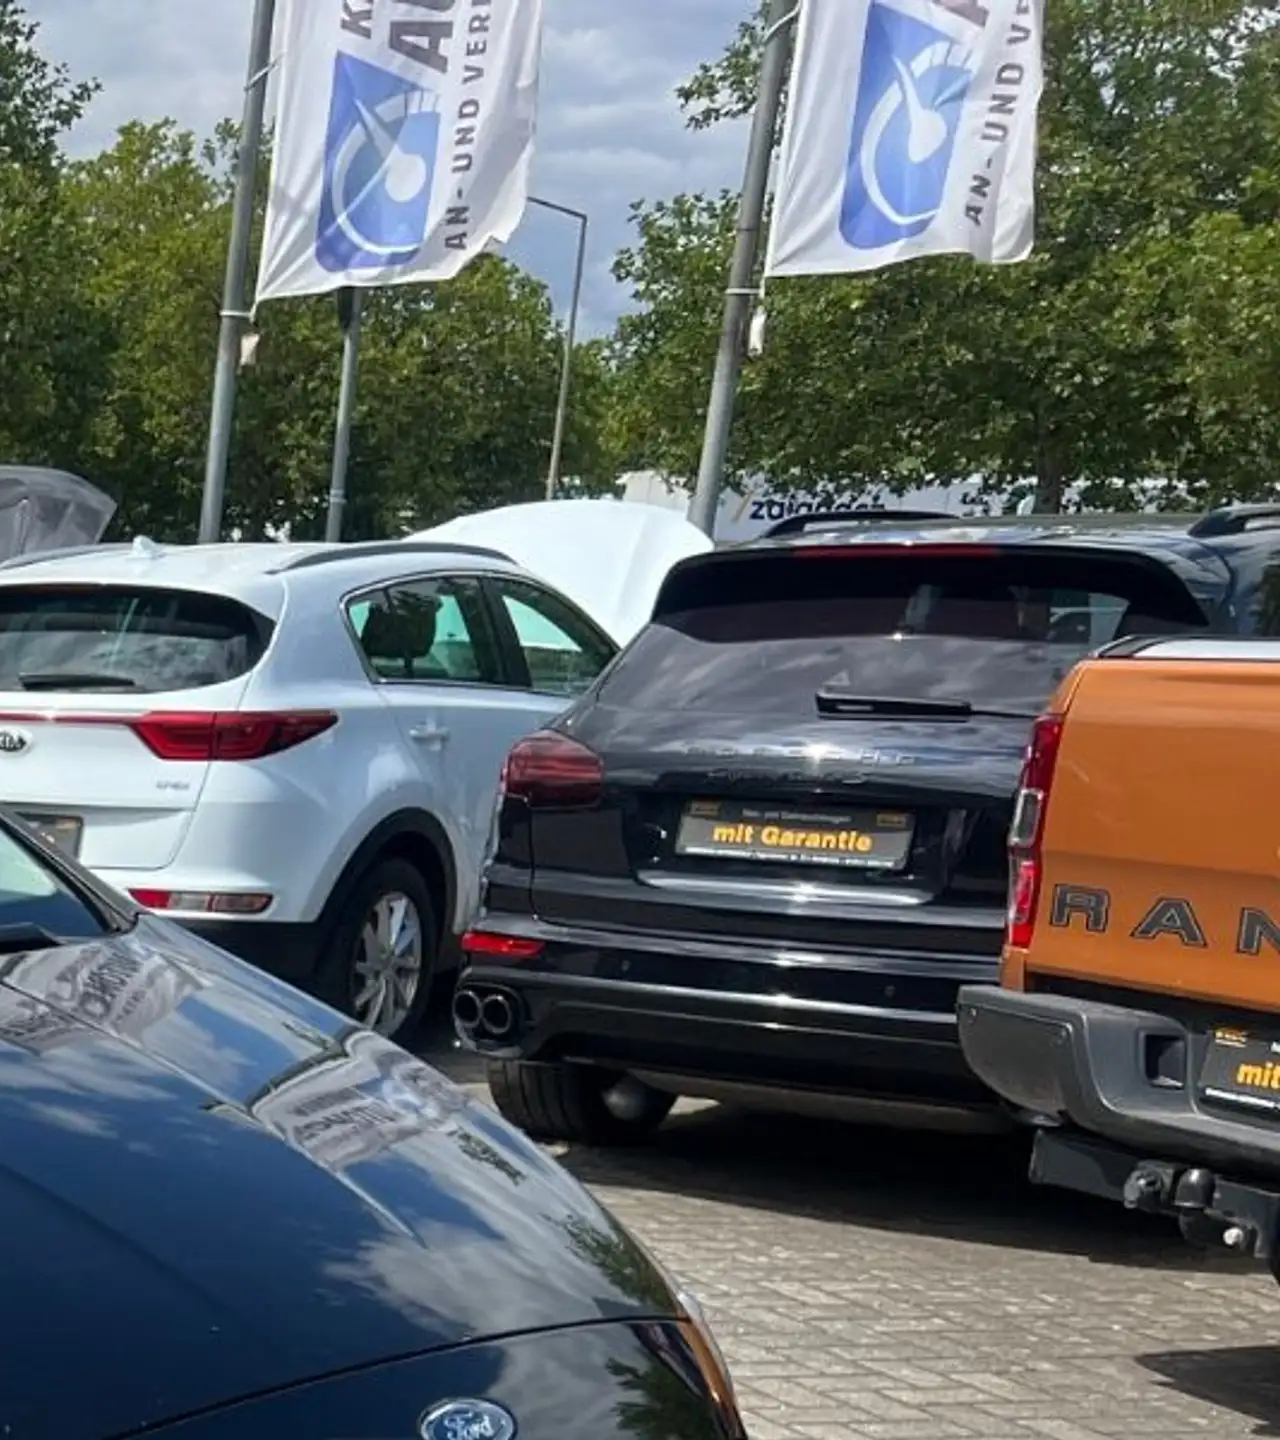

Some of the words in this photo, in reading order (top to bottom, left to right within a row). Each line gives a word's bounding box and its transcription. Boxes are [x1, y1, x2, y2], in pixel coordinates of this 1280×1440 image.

[340, 0, 374, 39] K
[388, 0, 456, 75] A
[462, 0, 491, 84] VER
[452, 98, 480, 174] UND
[965, 157, 993, 226] AN-
[980, 62, 1024, 143] UND
[444, 187, 470, 250] AN-
[712, 822, 754, 844] mit
[760, 824, 873, 852] Garantie
